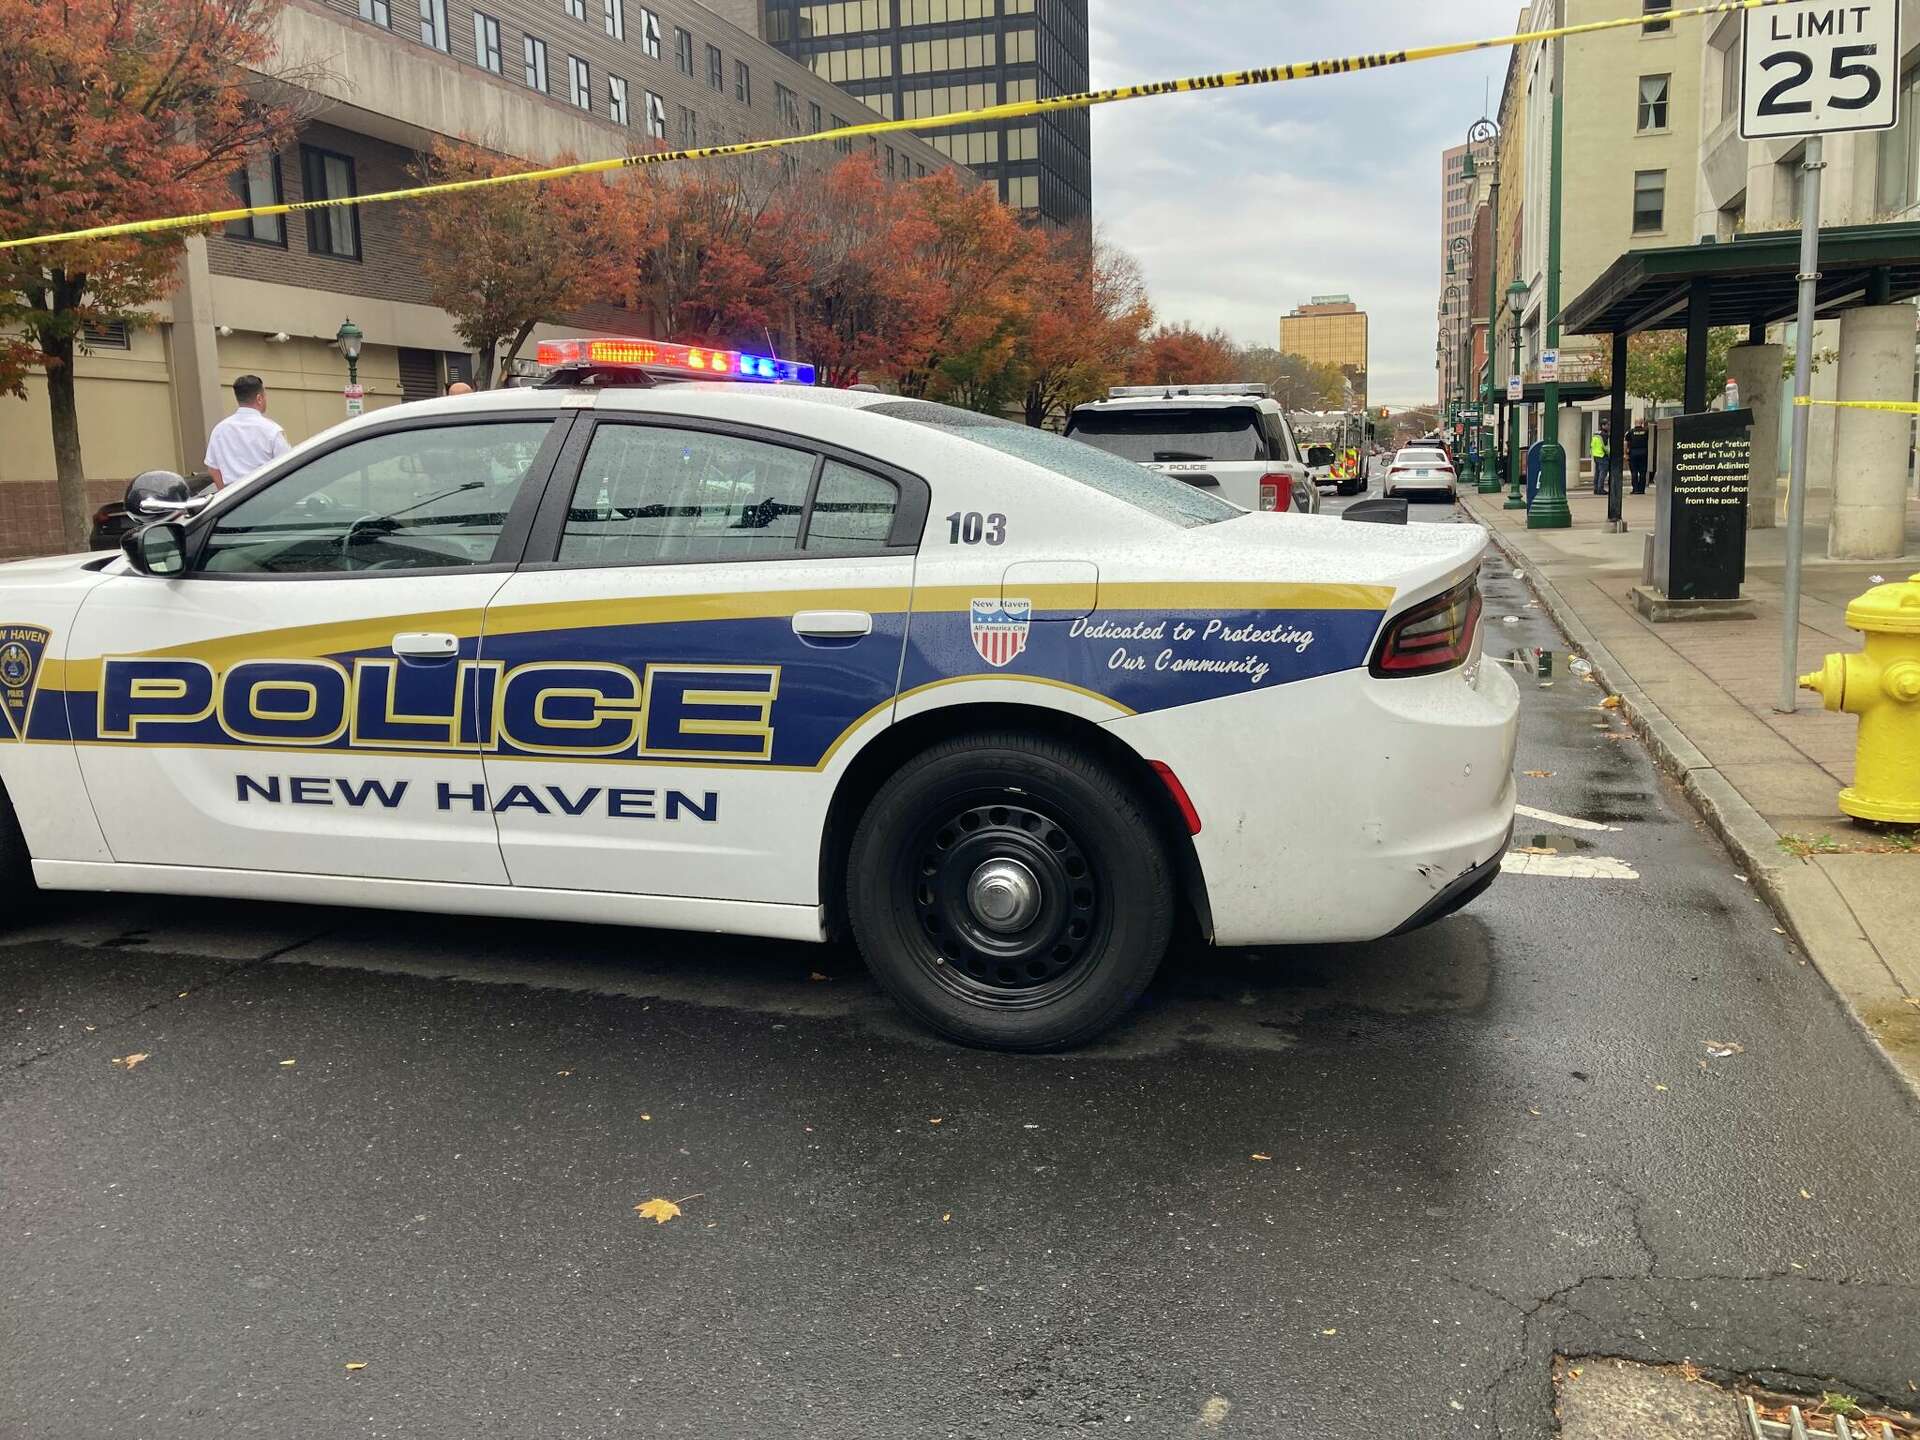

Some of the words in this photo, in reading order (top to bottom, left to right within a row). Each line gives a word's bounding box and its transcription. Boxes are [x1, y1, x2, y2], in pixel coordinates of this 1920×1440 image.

[1771, 6, 1871, 41] LIMIT
[1756, 43, 1882, 117] 25
[1677, 441, 1709, 449] Sankofa
[1711, 441, 1723, 450] (or
[1682, 452, 1696, 460] get
[1718, 451, 1736, 459] Twi)
[1676, 463, 1715, 471] Ghanaian
[1680, 474, 1709, 483] symbol
[1674, 485, 1720, 494] importance
[1721, 485, 1730, 493] of
[1685, 497, 1704, 505] from
[1706, 497, 1719, 505] the
[945, 511, 1007, 546] 103
[973, 600, 994, 608] New
[1000, 600, 1030, 608] Haven
[10, 630, 46, 644] HAVEN
[1068, 617, 1165, 640] Dedicated
[1173, 621, 1196, 642] to
[1202, 619, 1315, 653] Protecting
[1107, 647, 1146, 671] Our
[1154, 648, 1270, 683] Community
[97, 656, 781, 761] POLICE
[236, 774, 408, 808] NEW
[437, 782, 719, 822] HAVEN
